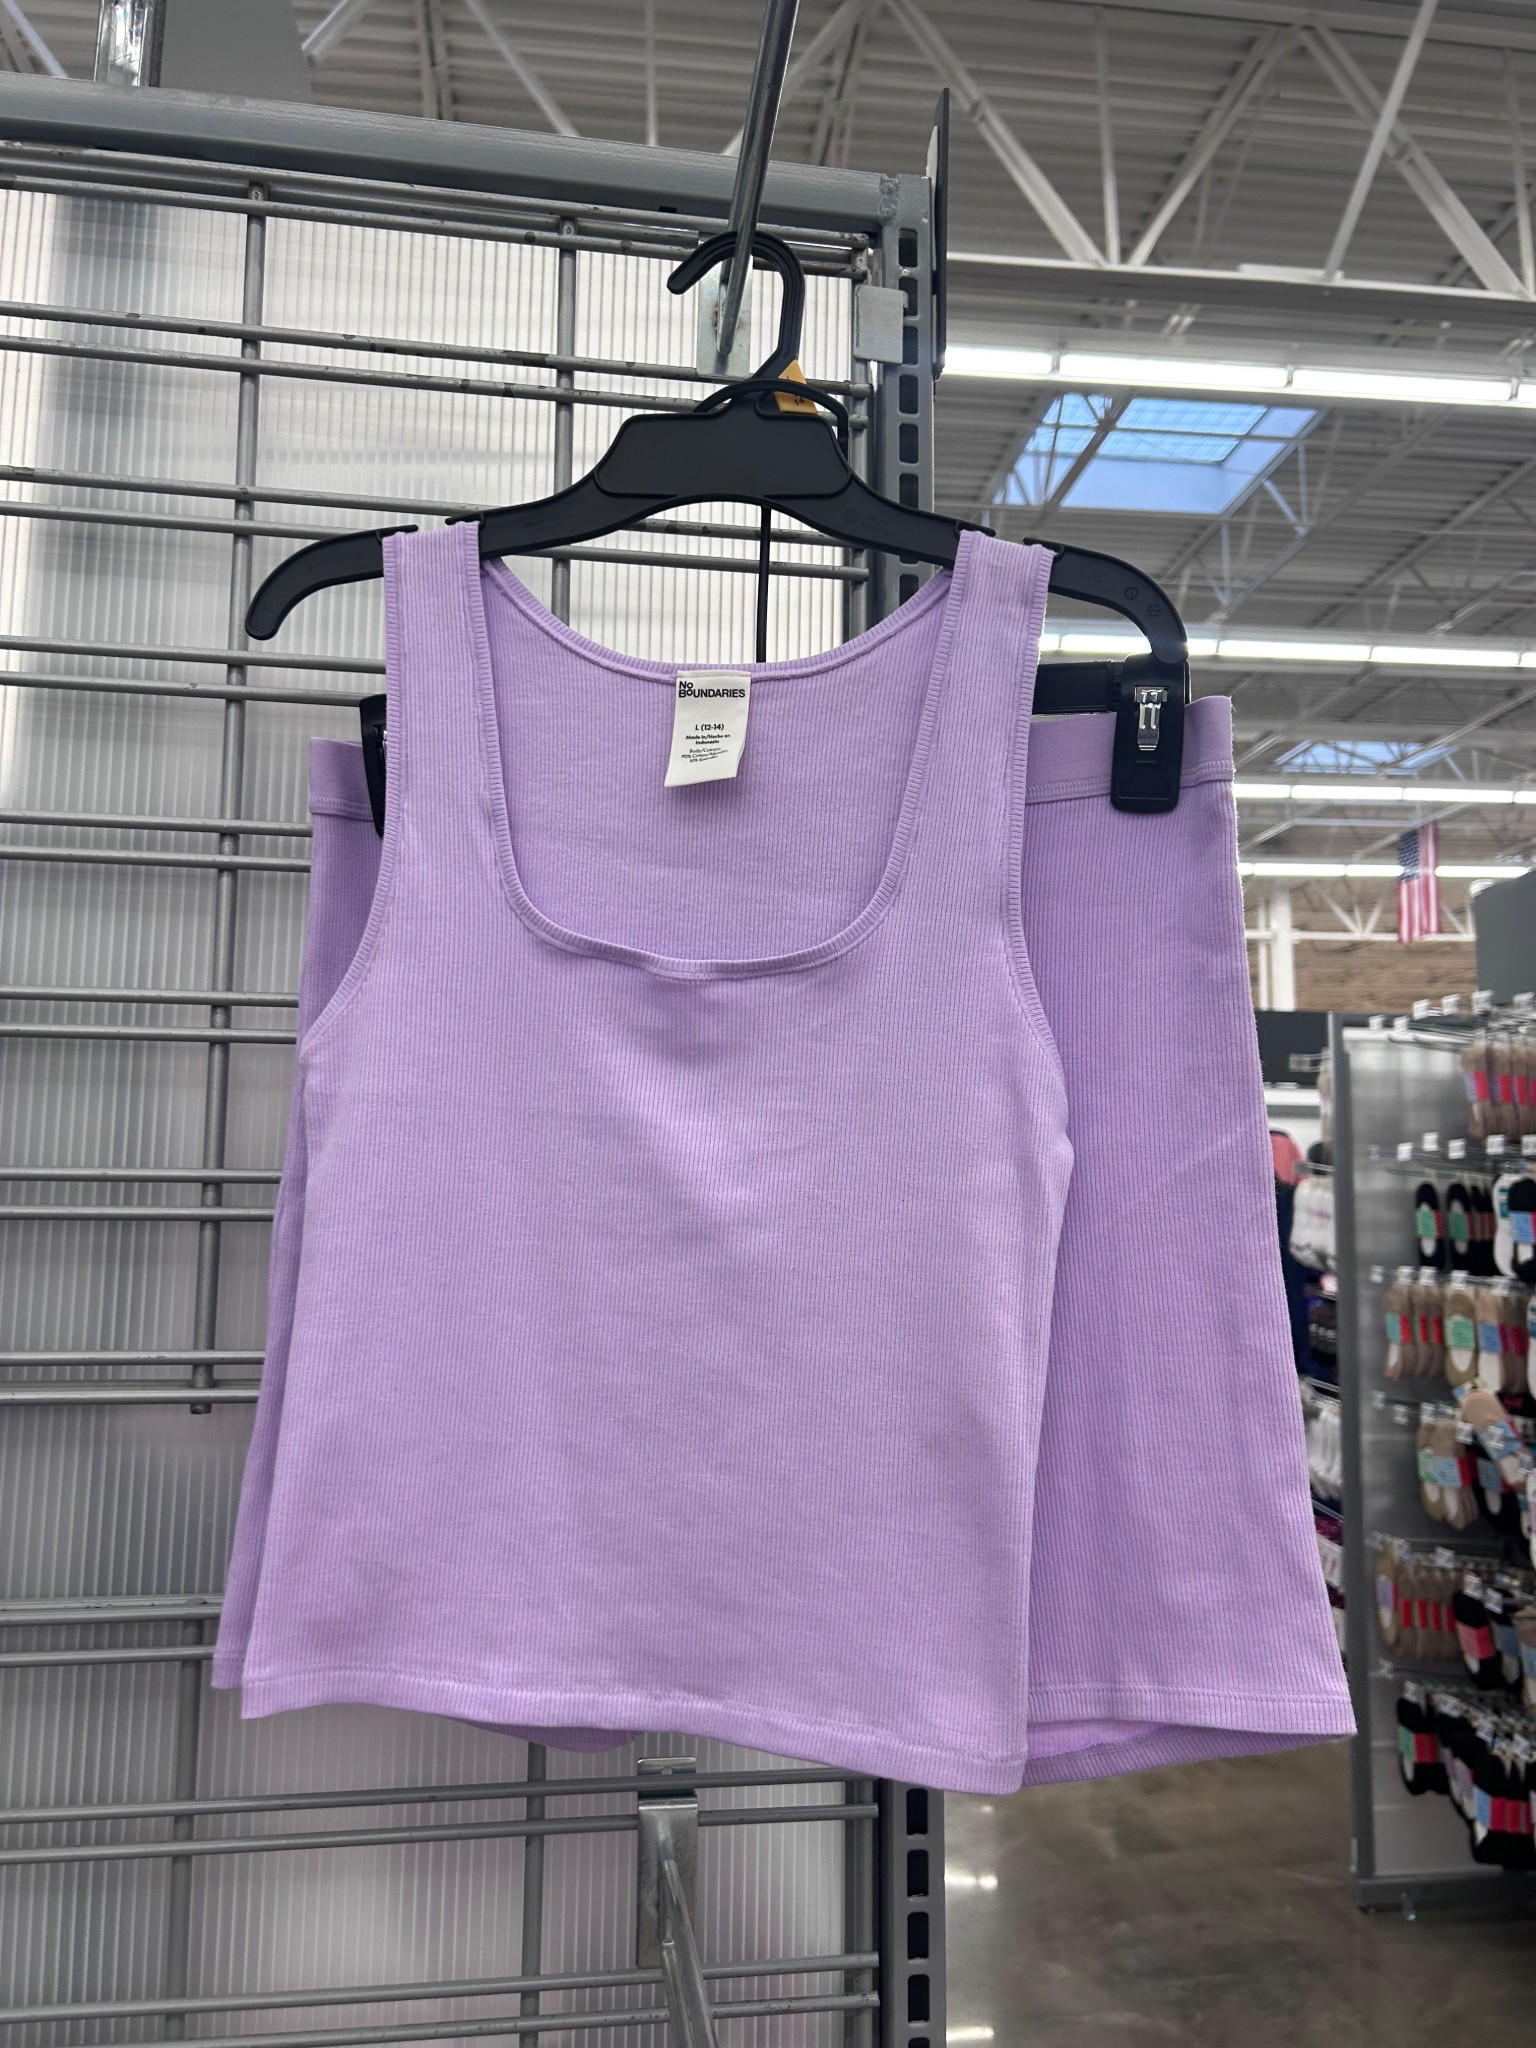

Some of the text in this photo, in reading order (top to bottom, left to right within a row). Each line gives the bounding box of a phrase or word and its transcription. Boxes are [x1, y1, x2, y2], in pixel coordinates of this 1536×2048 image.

[679, 681, 694, 689] No
[678, 689, 746, 698] BOUNDARIES
[701, 723, 725, 731] (12-14)
